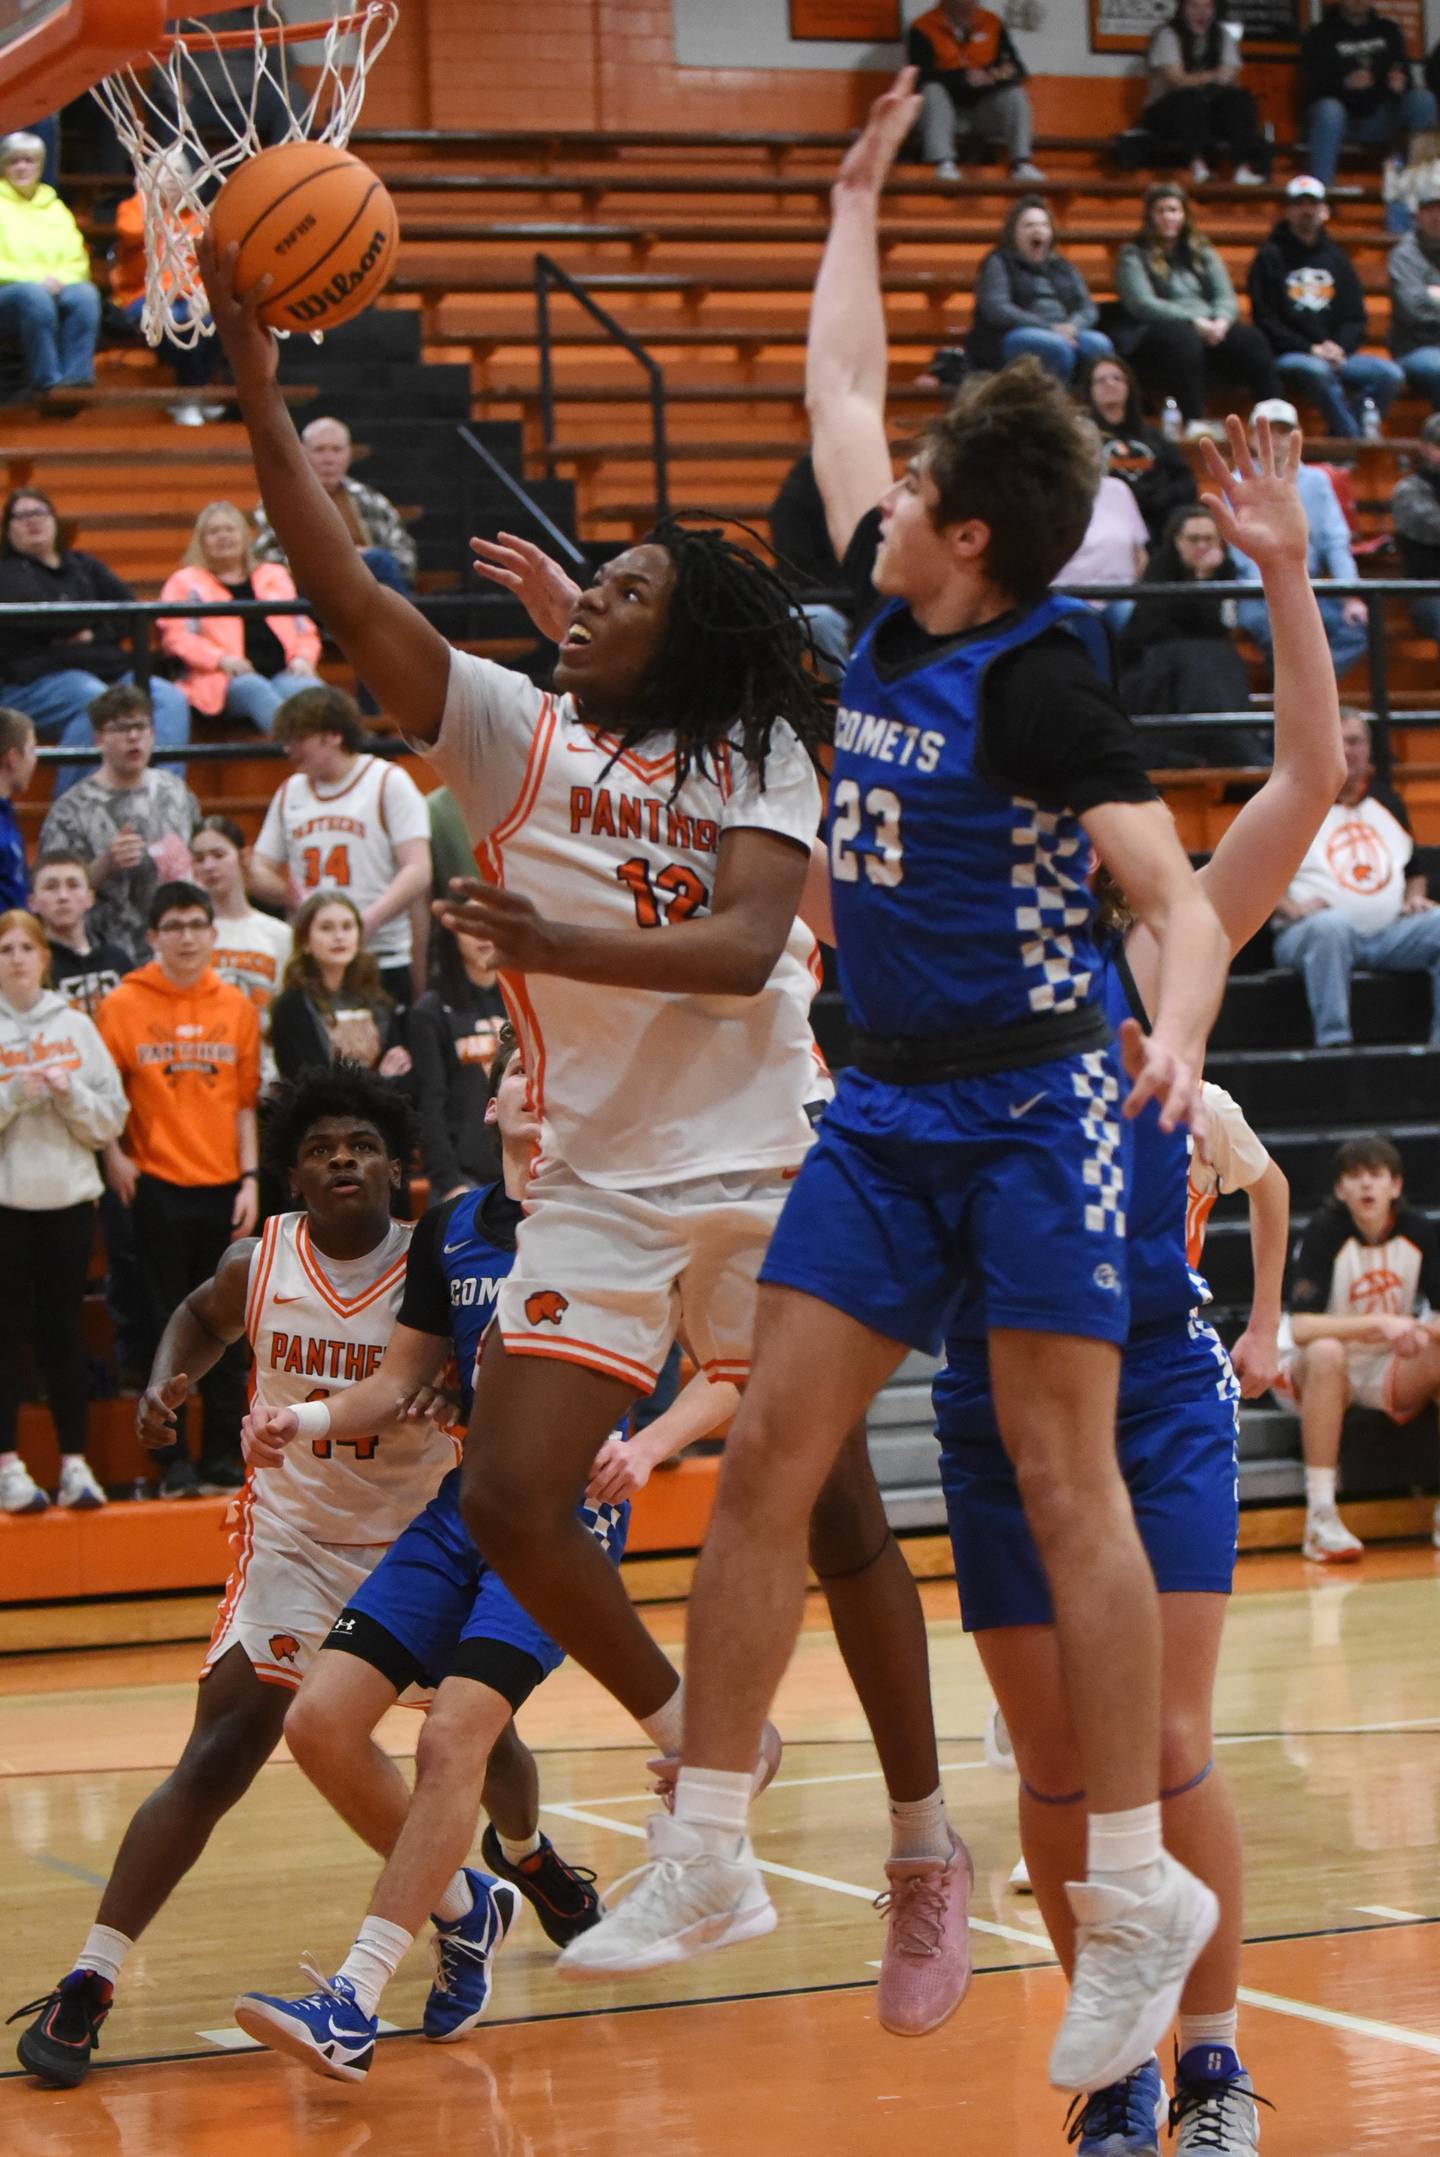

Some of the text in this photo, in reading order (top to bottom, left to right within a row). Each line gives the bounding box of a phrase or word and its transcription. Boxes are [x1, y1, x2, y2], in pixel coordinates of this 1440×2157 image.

[284, 230, 386, 321] Wilson
[831, 778, 904, 888] 23
[616, 857, 711, 929] 12
[270, 1331, 388, 1381] PANTHE
